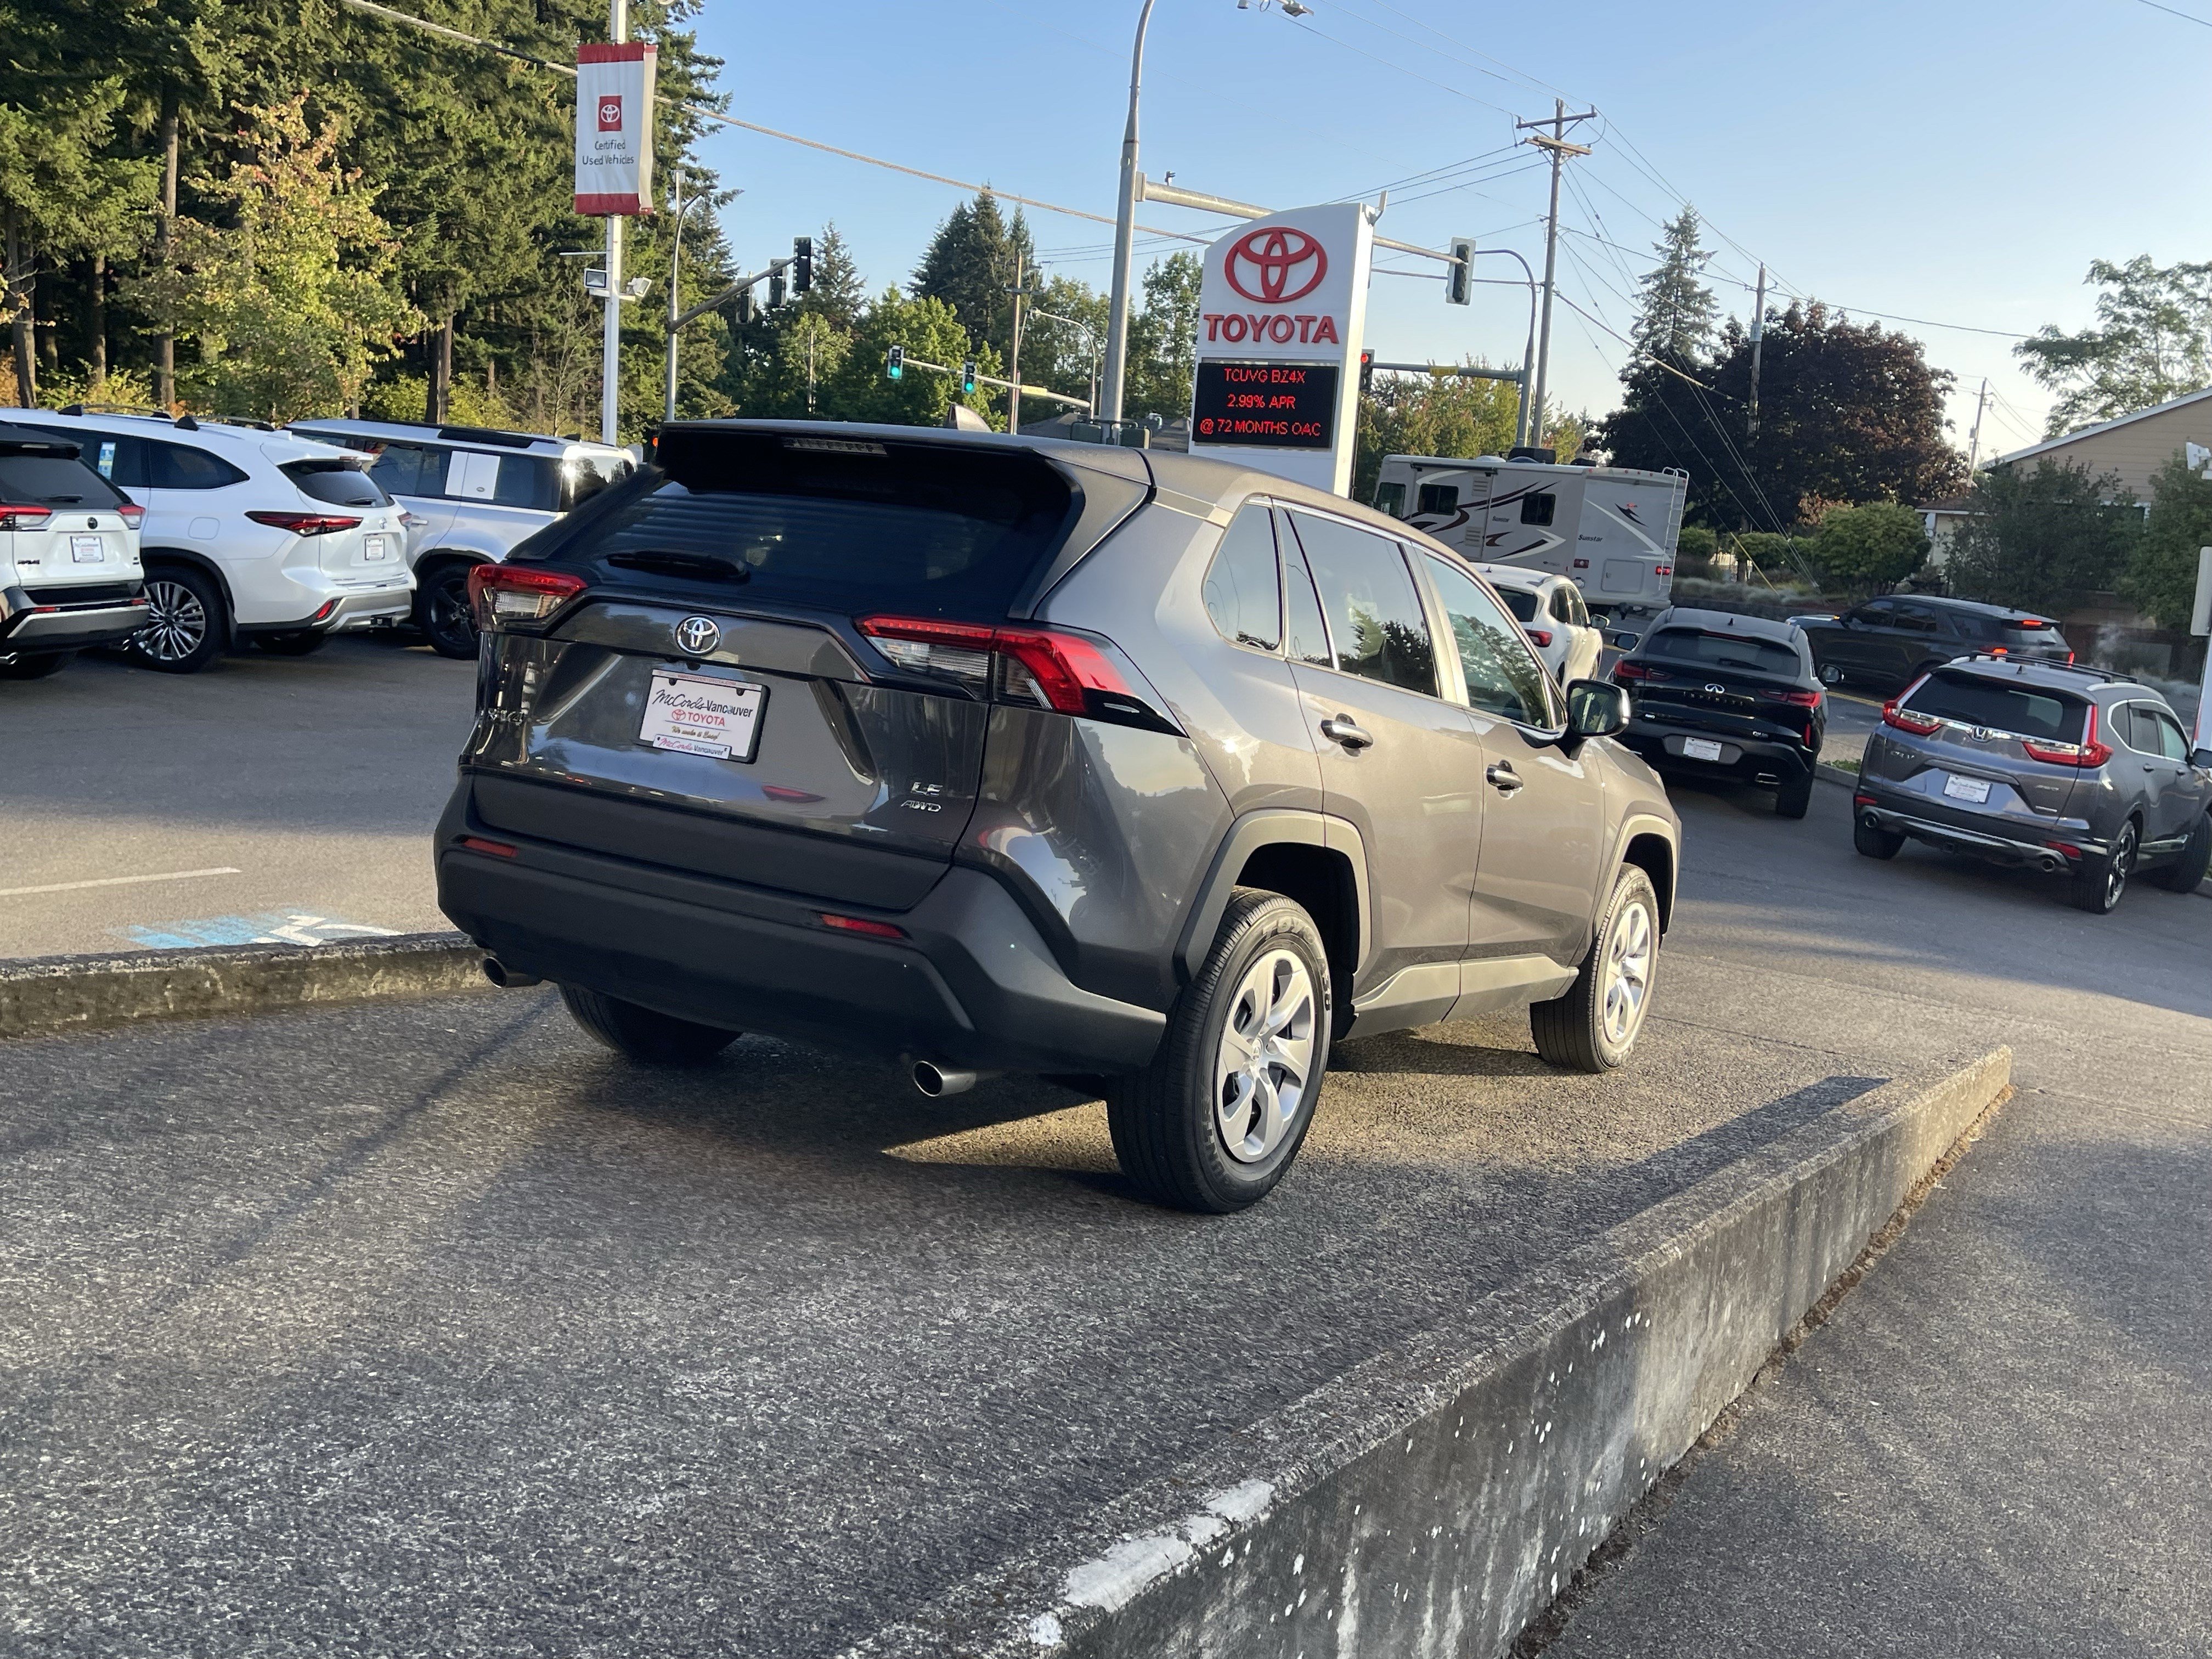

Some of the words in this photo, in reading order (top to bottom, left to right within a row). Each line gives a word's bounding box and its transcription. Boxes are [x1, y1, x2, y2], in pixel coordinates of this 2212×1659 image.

[595, 139, 626, 150] Certified
[582, 155, 603, 165] Used
[605, 154, 634, 164] Vehicles
[1204, 314, 1339, 345] TOYOTA
[1271, 369, 1306, 383] BZ4X
[1227, 393, 1266, 408] 2.99%
[1269, 396, 1296, 410] APR
[1200, 419, 1214, 435] @
[1217, 419, 1232, 432] 72
[1234, 420, 1289, 435] MONTHS
[1291, 422, 1321, 436] OAC
[688, 712, 725, 726] TOYOTA
[694, 745, 723, 755] Vancouver
[911, 782, 943, 797] LE
[901, 800, 942, 812] AWD
[1263, 916, 1316, 944] TOYO
